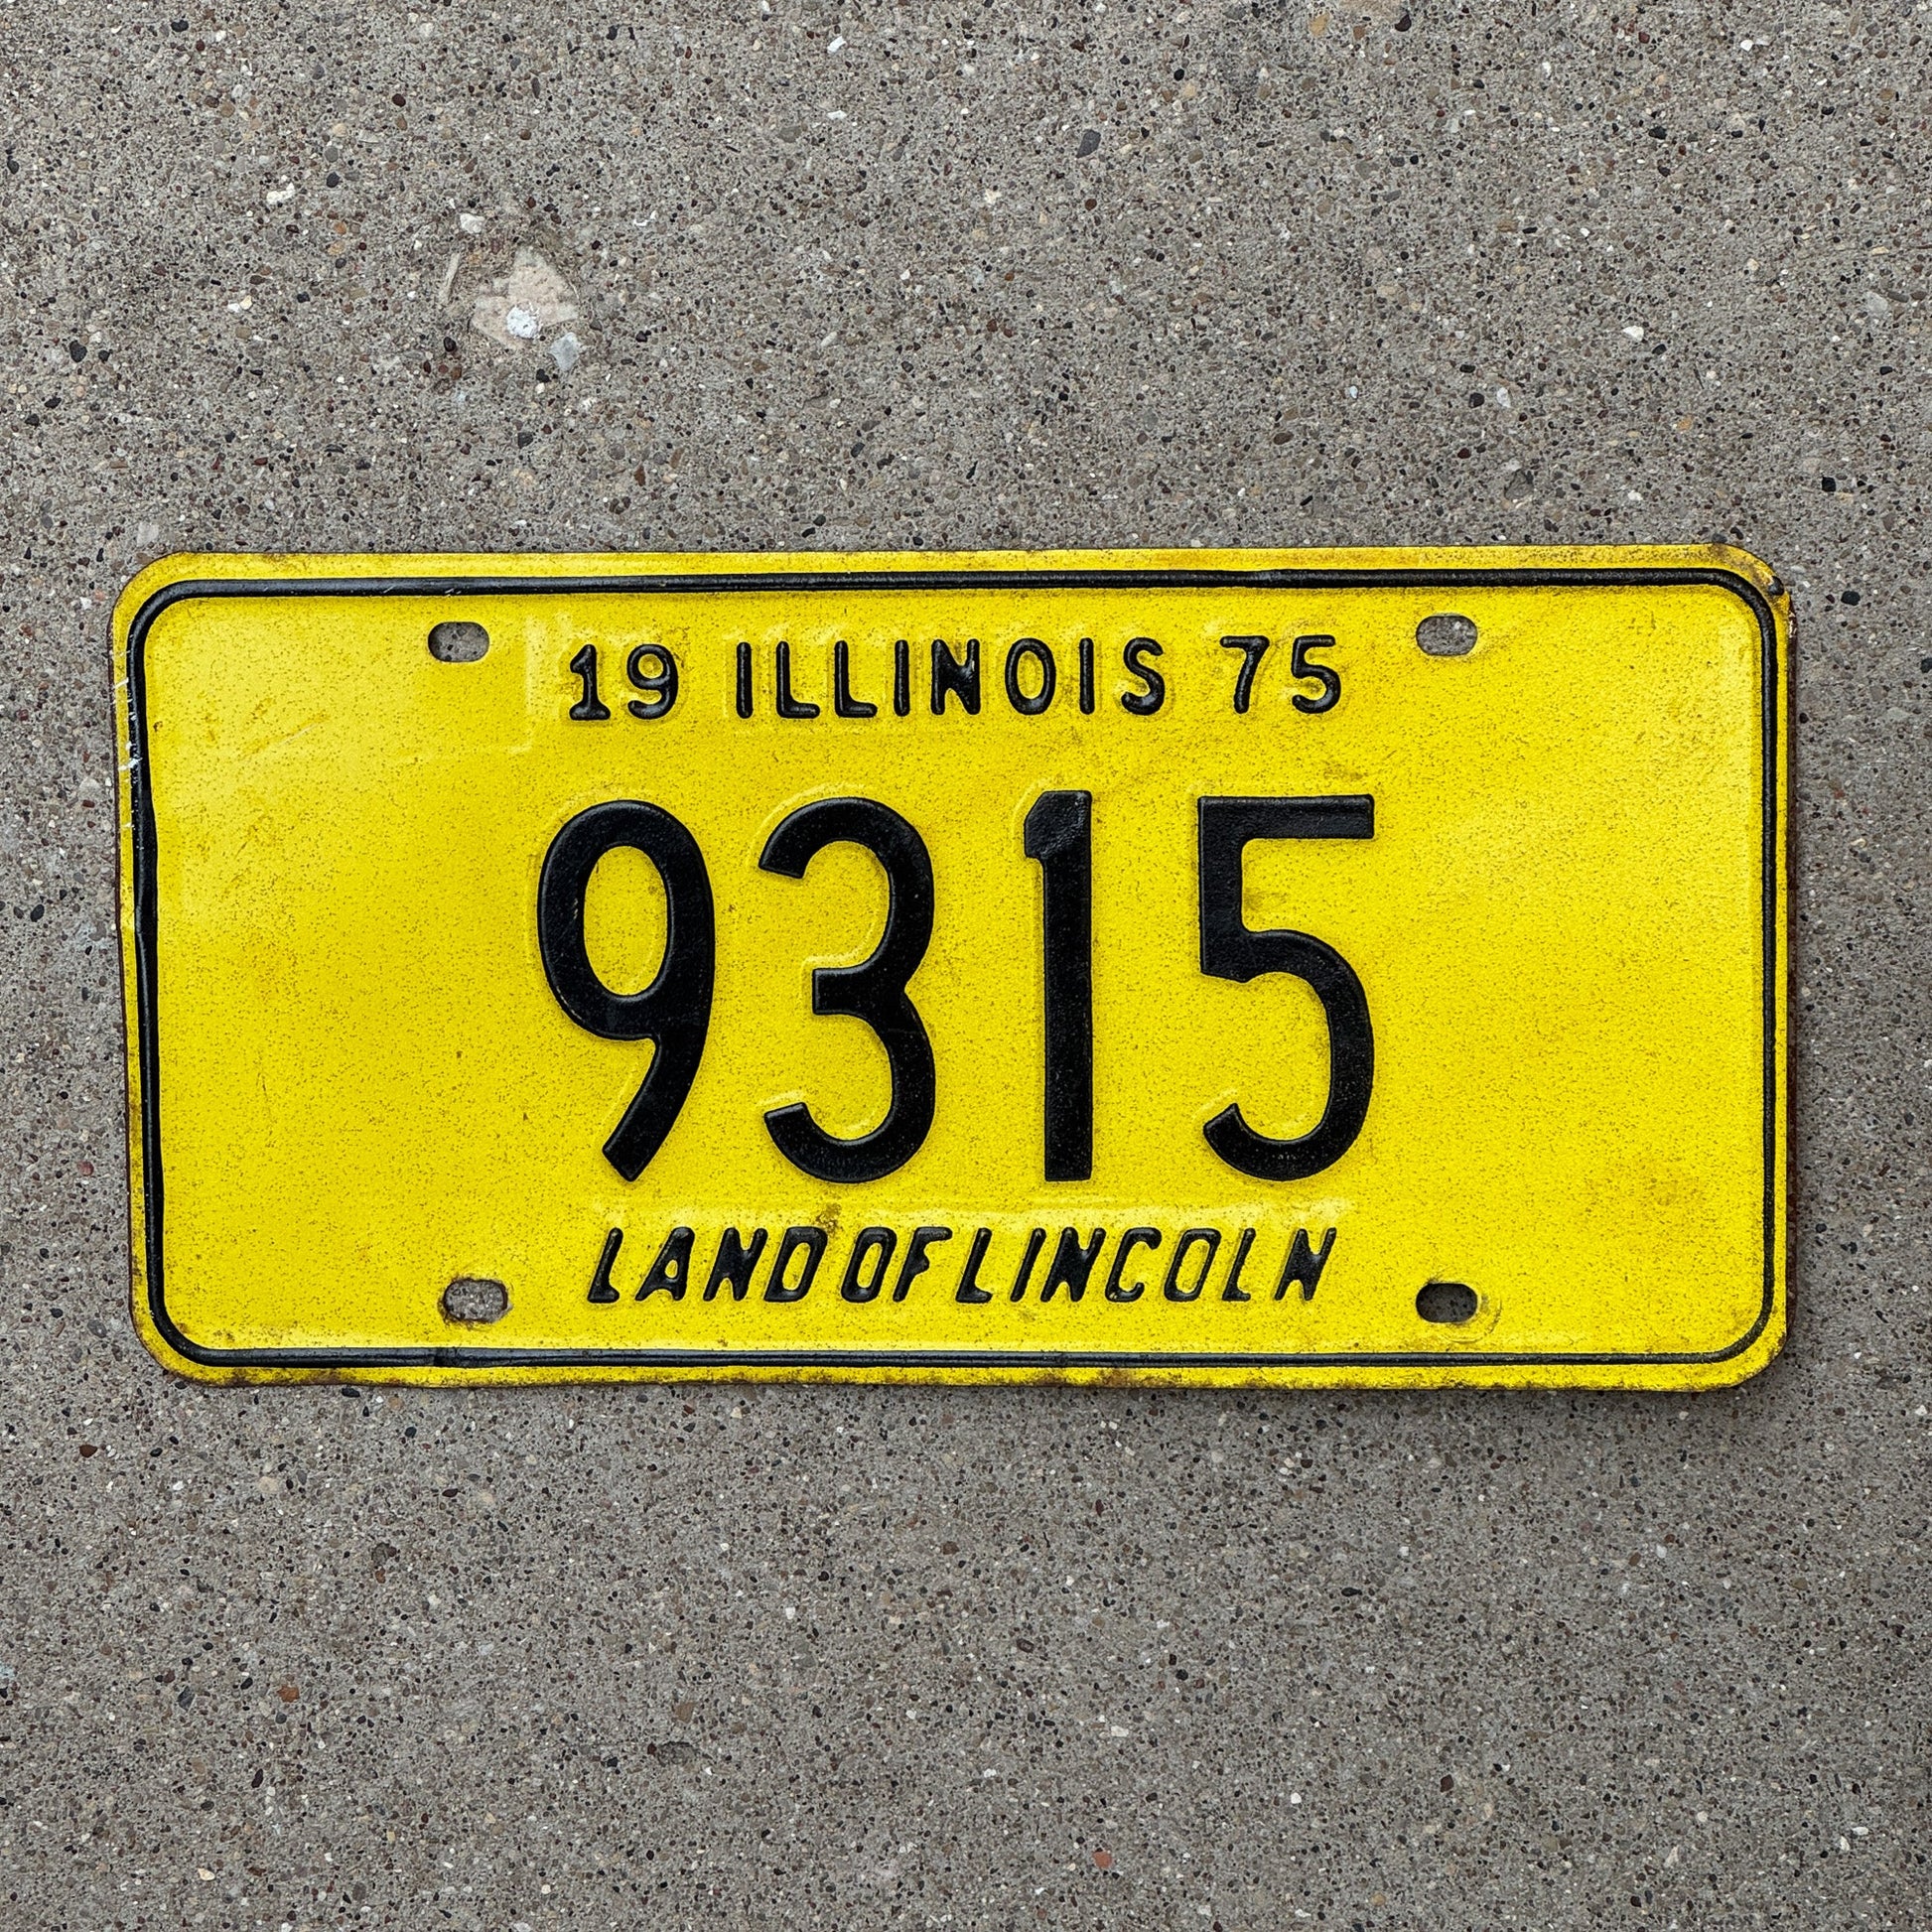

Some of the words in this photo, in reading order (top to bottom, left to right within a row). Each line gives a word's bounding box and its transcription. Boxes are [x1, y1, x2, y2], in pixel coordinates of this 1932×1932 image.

[569, 642, 680, 722] 19
[736, 636, 1167, 720] ILLINOIS
[1219, 633, 1342, 716] 75
[536, 789, 1376, 1184] 9315
[587, 1225, 829, 1305] LAND
[840, 1226, 953, 1304] OF
[954, 1226, 1338, 1305] LINCOLN
